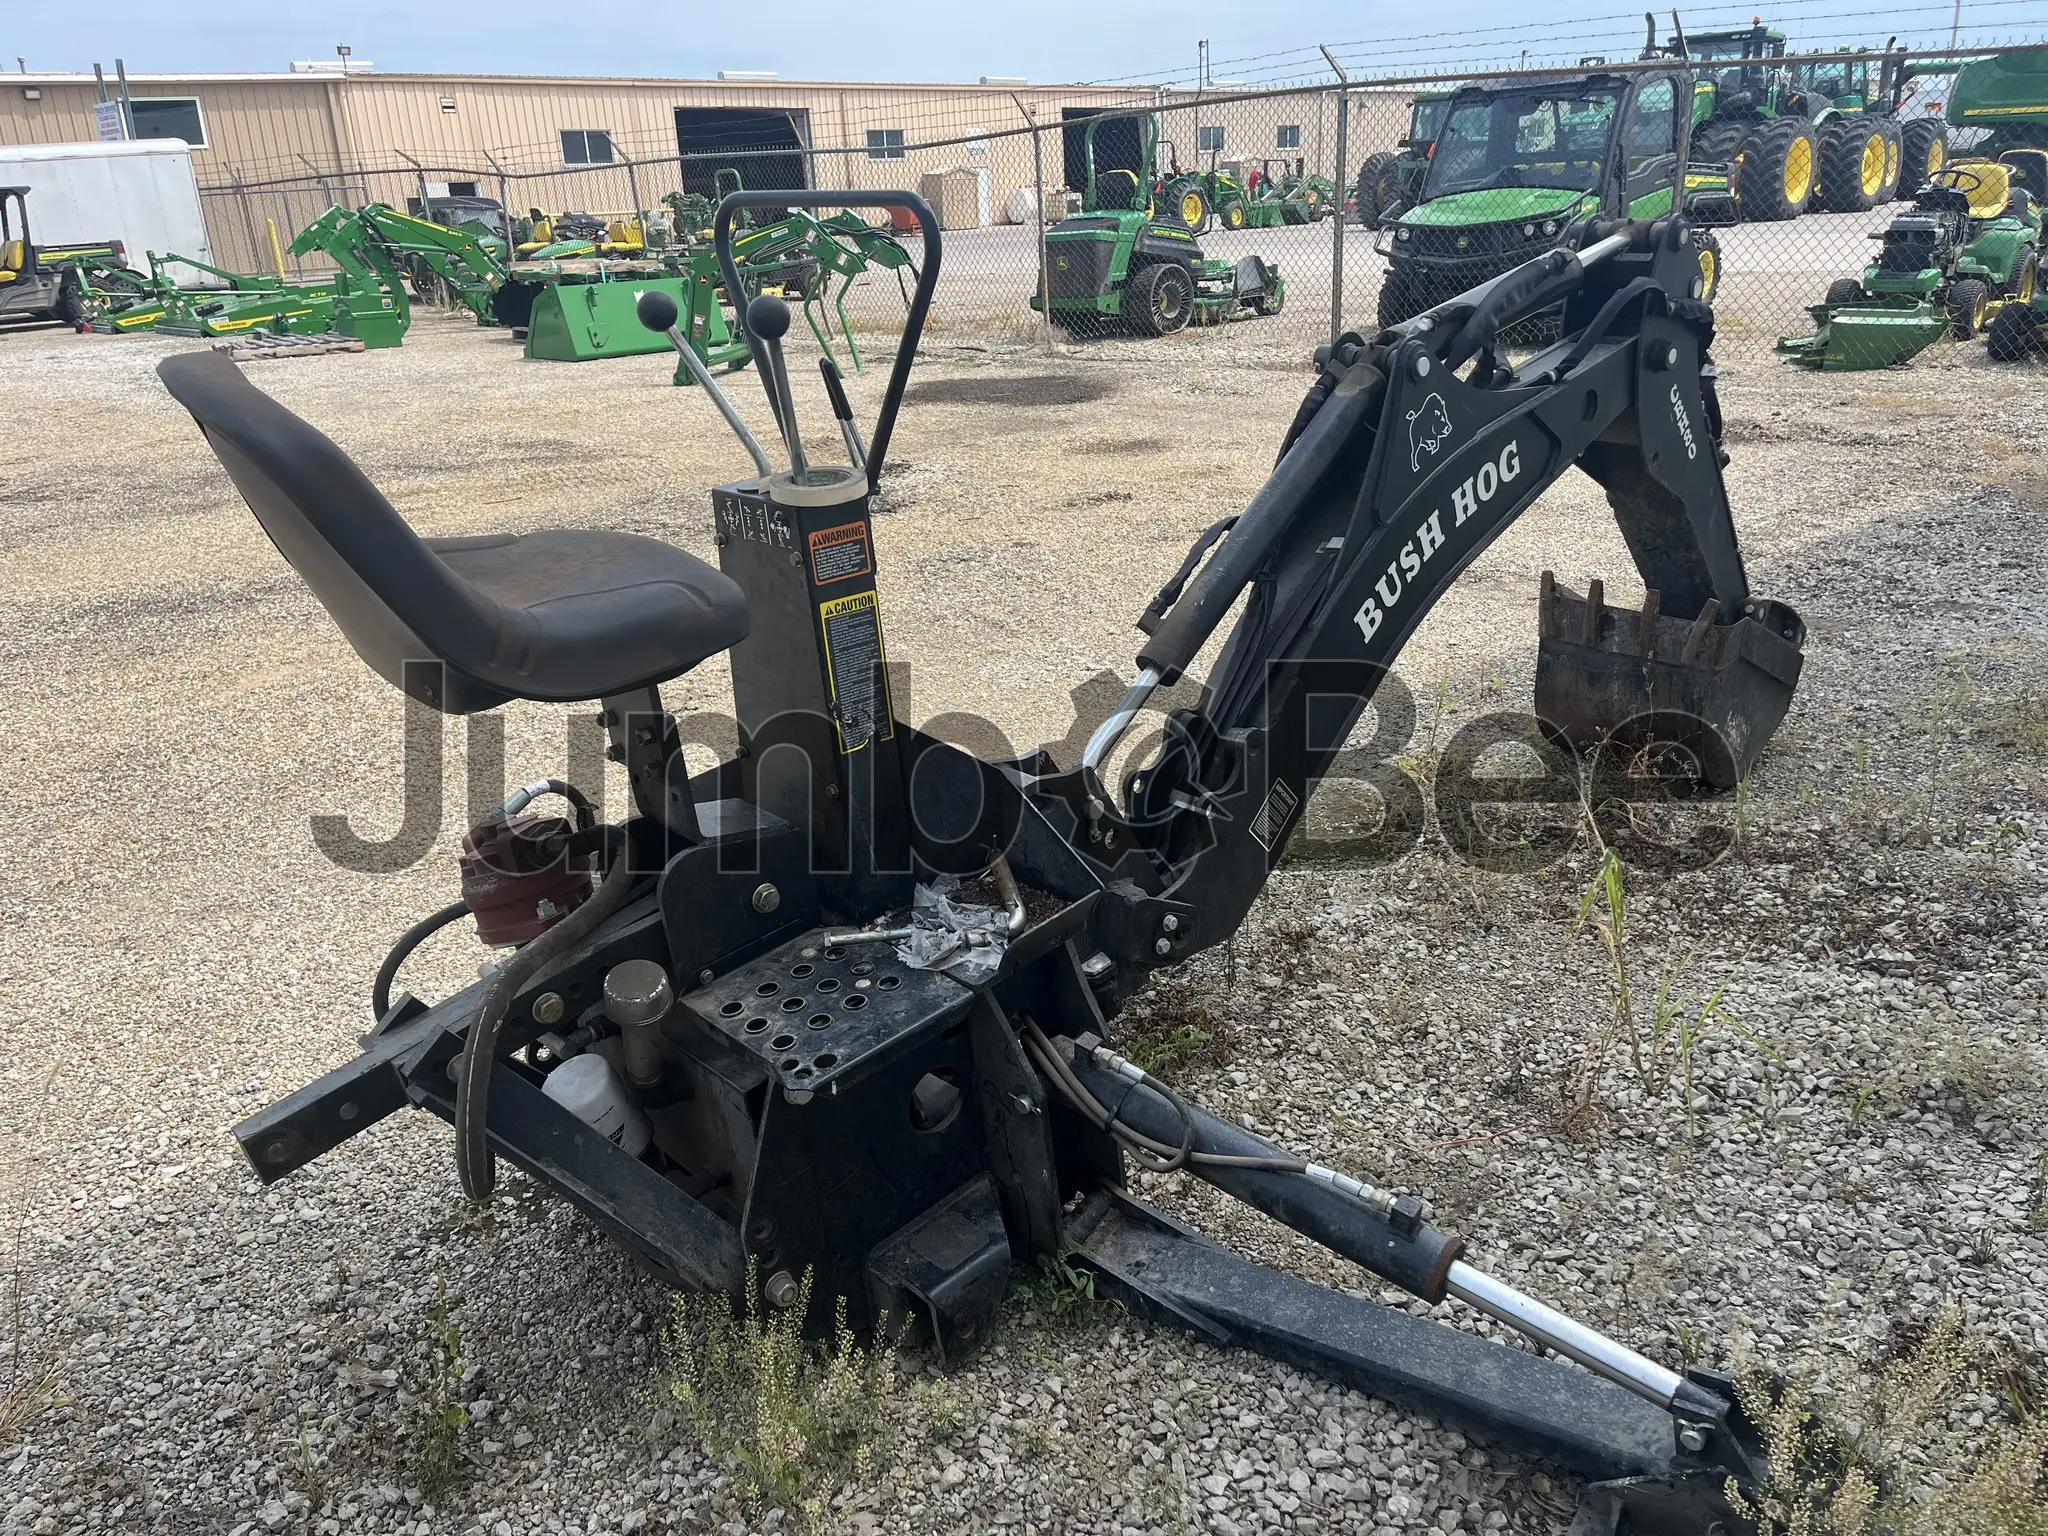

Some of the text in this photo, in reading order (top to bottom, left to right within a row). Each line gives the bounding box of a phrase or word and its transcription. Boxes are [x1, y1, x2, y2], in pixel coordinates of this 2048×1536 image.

[1670, 383, 1697, 460] CBH80
[821, 525, 865, 545] WARNING
[1353, 439, 1521, 644] BUSH HOG
[834, 593, 874, 614] CAUTION
